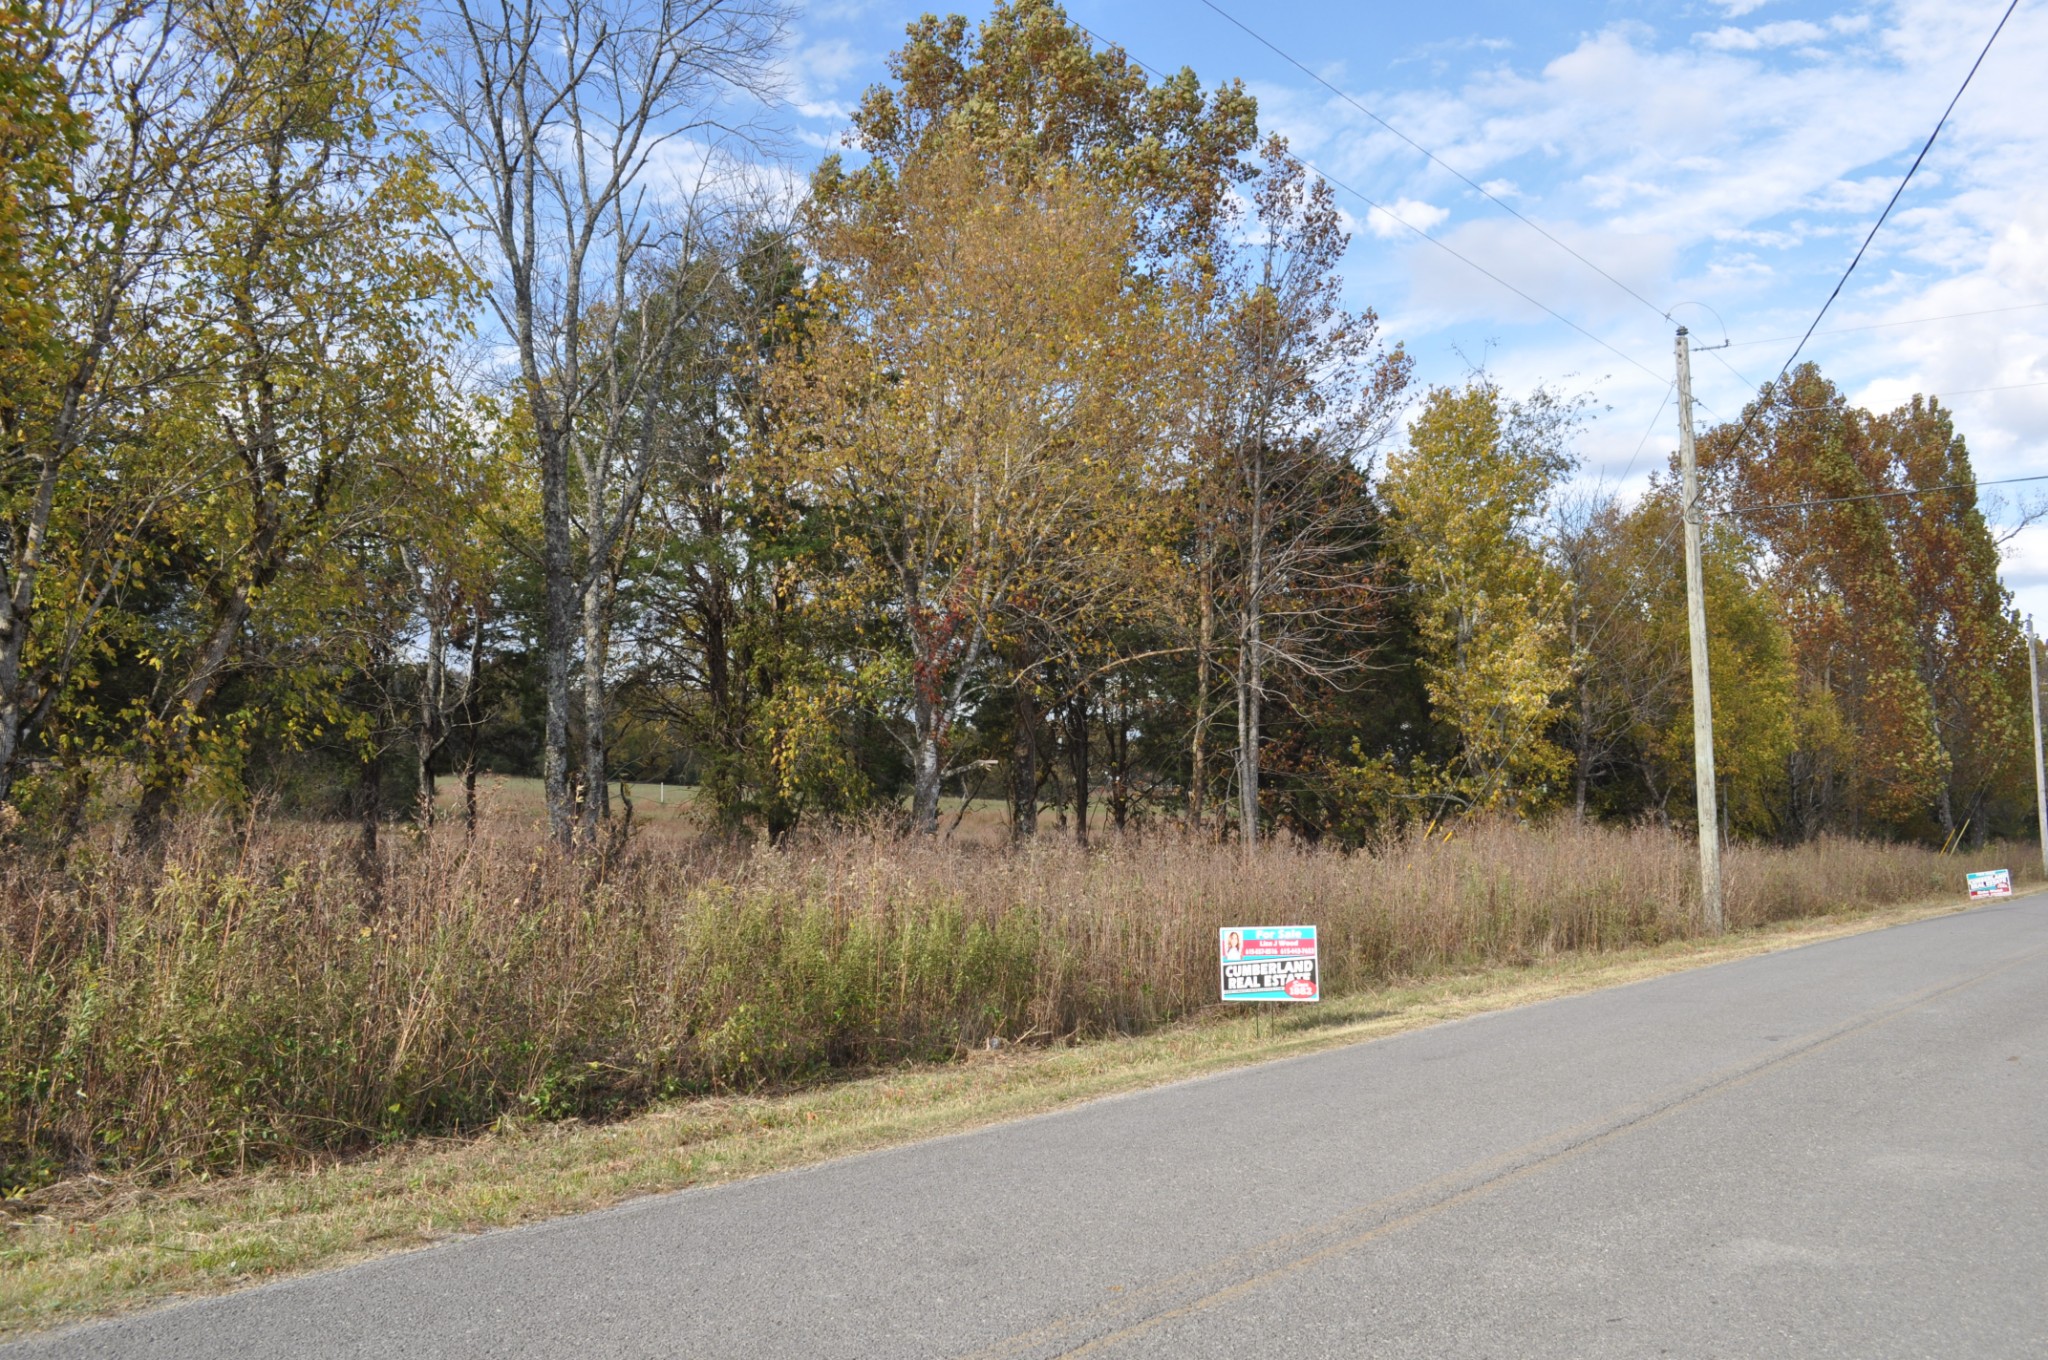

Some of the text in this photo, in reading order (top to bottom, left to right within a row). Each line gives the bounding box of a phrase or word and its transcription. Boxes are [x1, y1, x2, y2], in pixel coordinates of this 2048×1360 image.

[1256, 929, 1302, 939] For Sale
[1225, 960, 1313, 978] CUMBERLAND
[1228, 975, 1261, 989] REAL
